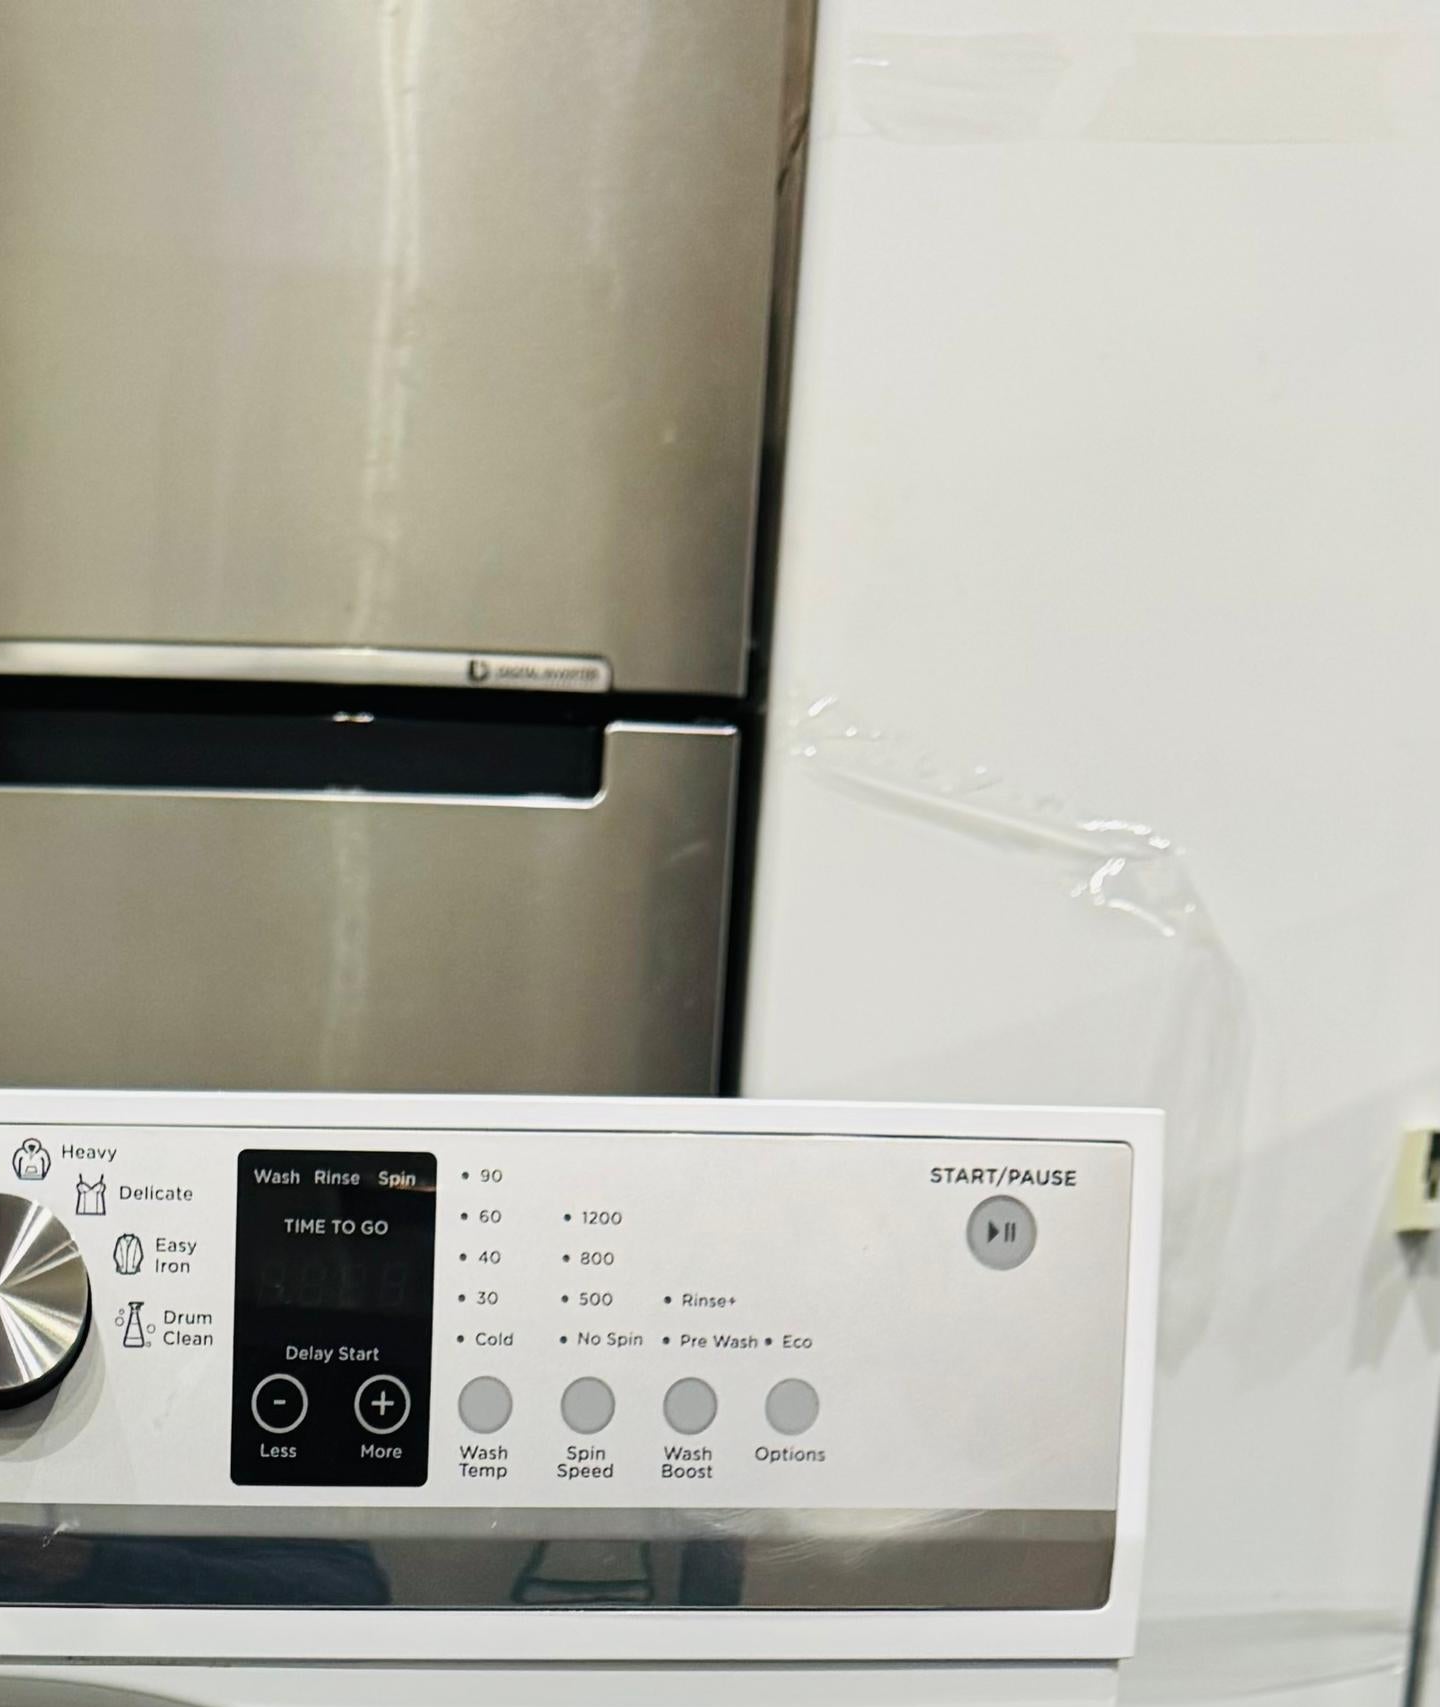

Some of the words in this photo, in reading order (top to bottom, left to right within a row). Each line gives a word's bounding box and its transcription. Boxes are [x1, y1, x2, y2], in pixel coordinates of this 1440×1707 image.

[61, 1144, 117, 1163] Heavy
[253, 1168, 301, 1185] Wash
[314, 1169, 361, 1186] Rinse
[378, 1170, 417, 1190] Spin
[480, 1168, 503, 1183] 90
[930, 1166, 1077, 1187] START/PAUSE
[119, 1185, 193, 1201] Delicate
[479, 1209, 502, 1224] 60
[582, 1211, 623, 1226] 1200
[283, 1218, 326, 1234] TIME
[331, 1219, 356, 1235] TO
[360, 1219, 389, 1236] GO
[155, 1237, 197, 1256] Easy
[478, 1250, 501, 1265] 40
[580, 1251, 615, 1266] 800
[155, 1258, 190, 1274] Iron
[476, 1290, 499, 1306] 30
[579, 1291, 614, 1307] 500
[163, 1309, 213, 1325] Drum
[162, 1330, 214, 1346] Clean
[475, 1332, 514, 1347] Cold
[577, 1331, 602, 1346] No
[606, 1331, 644, 1348] Spin
[680, 1333, 708, 1349] Pre
[712, 1334, 758, 1349] Wash
[782, 1334, 813, 1350] Eco
[285, 1345, 334, 1364] Delay
[338, 1345, 380, 1362] Start
[260, 1443, 297, 1458] Less
[360, 1444, 403, 1459] More
[459, 1445, 508, 1461] Wash
[566, 1445, 606, 1463] Spin
[663, 1446, 713, 1462] Wash
[754, 1446, 826, 1464] Options
[458, 1462, 508, 1480] Temp
[556, 1463, 614, 1481] Speed
[661, 1463, 713, 1479] Boost
